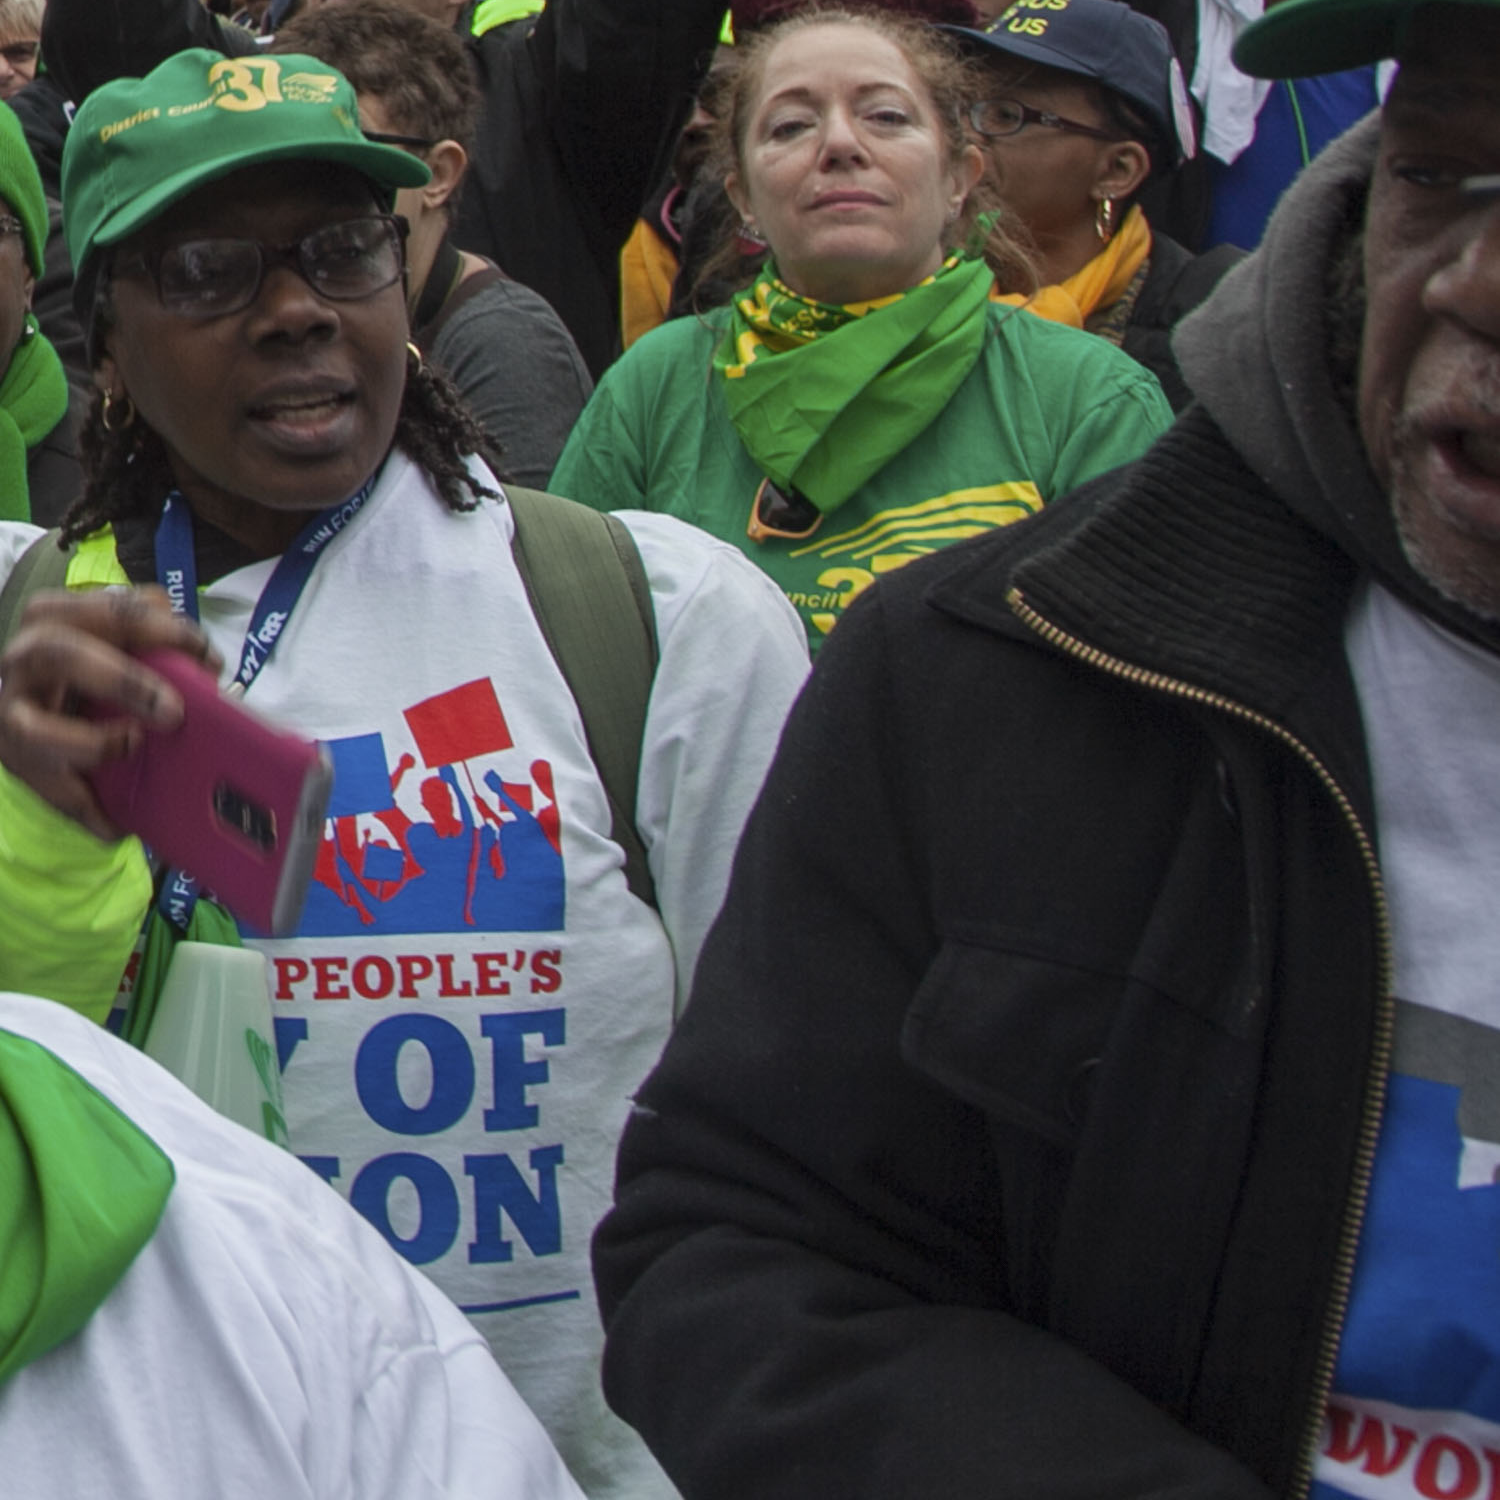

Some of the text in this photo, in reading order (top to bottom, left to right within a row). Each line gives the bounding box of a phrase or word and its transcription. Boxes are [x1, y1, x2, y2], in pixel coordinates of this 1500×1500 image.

[208, 56, 283, 112] 37
[166, 569, 186, 615] RUN
[275, 949, 563, 1001] PEOPLE'S
[354, 1007, 567, 1136] OF
